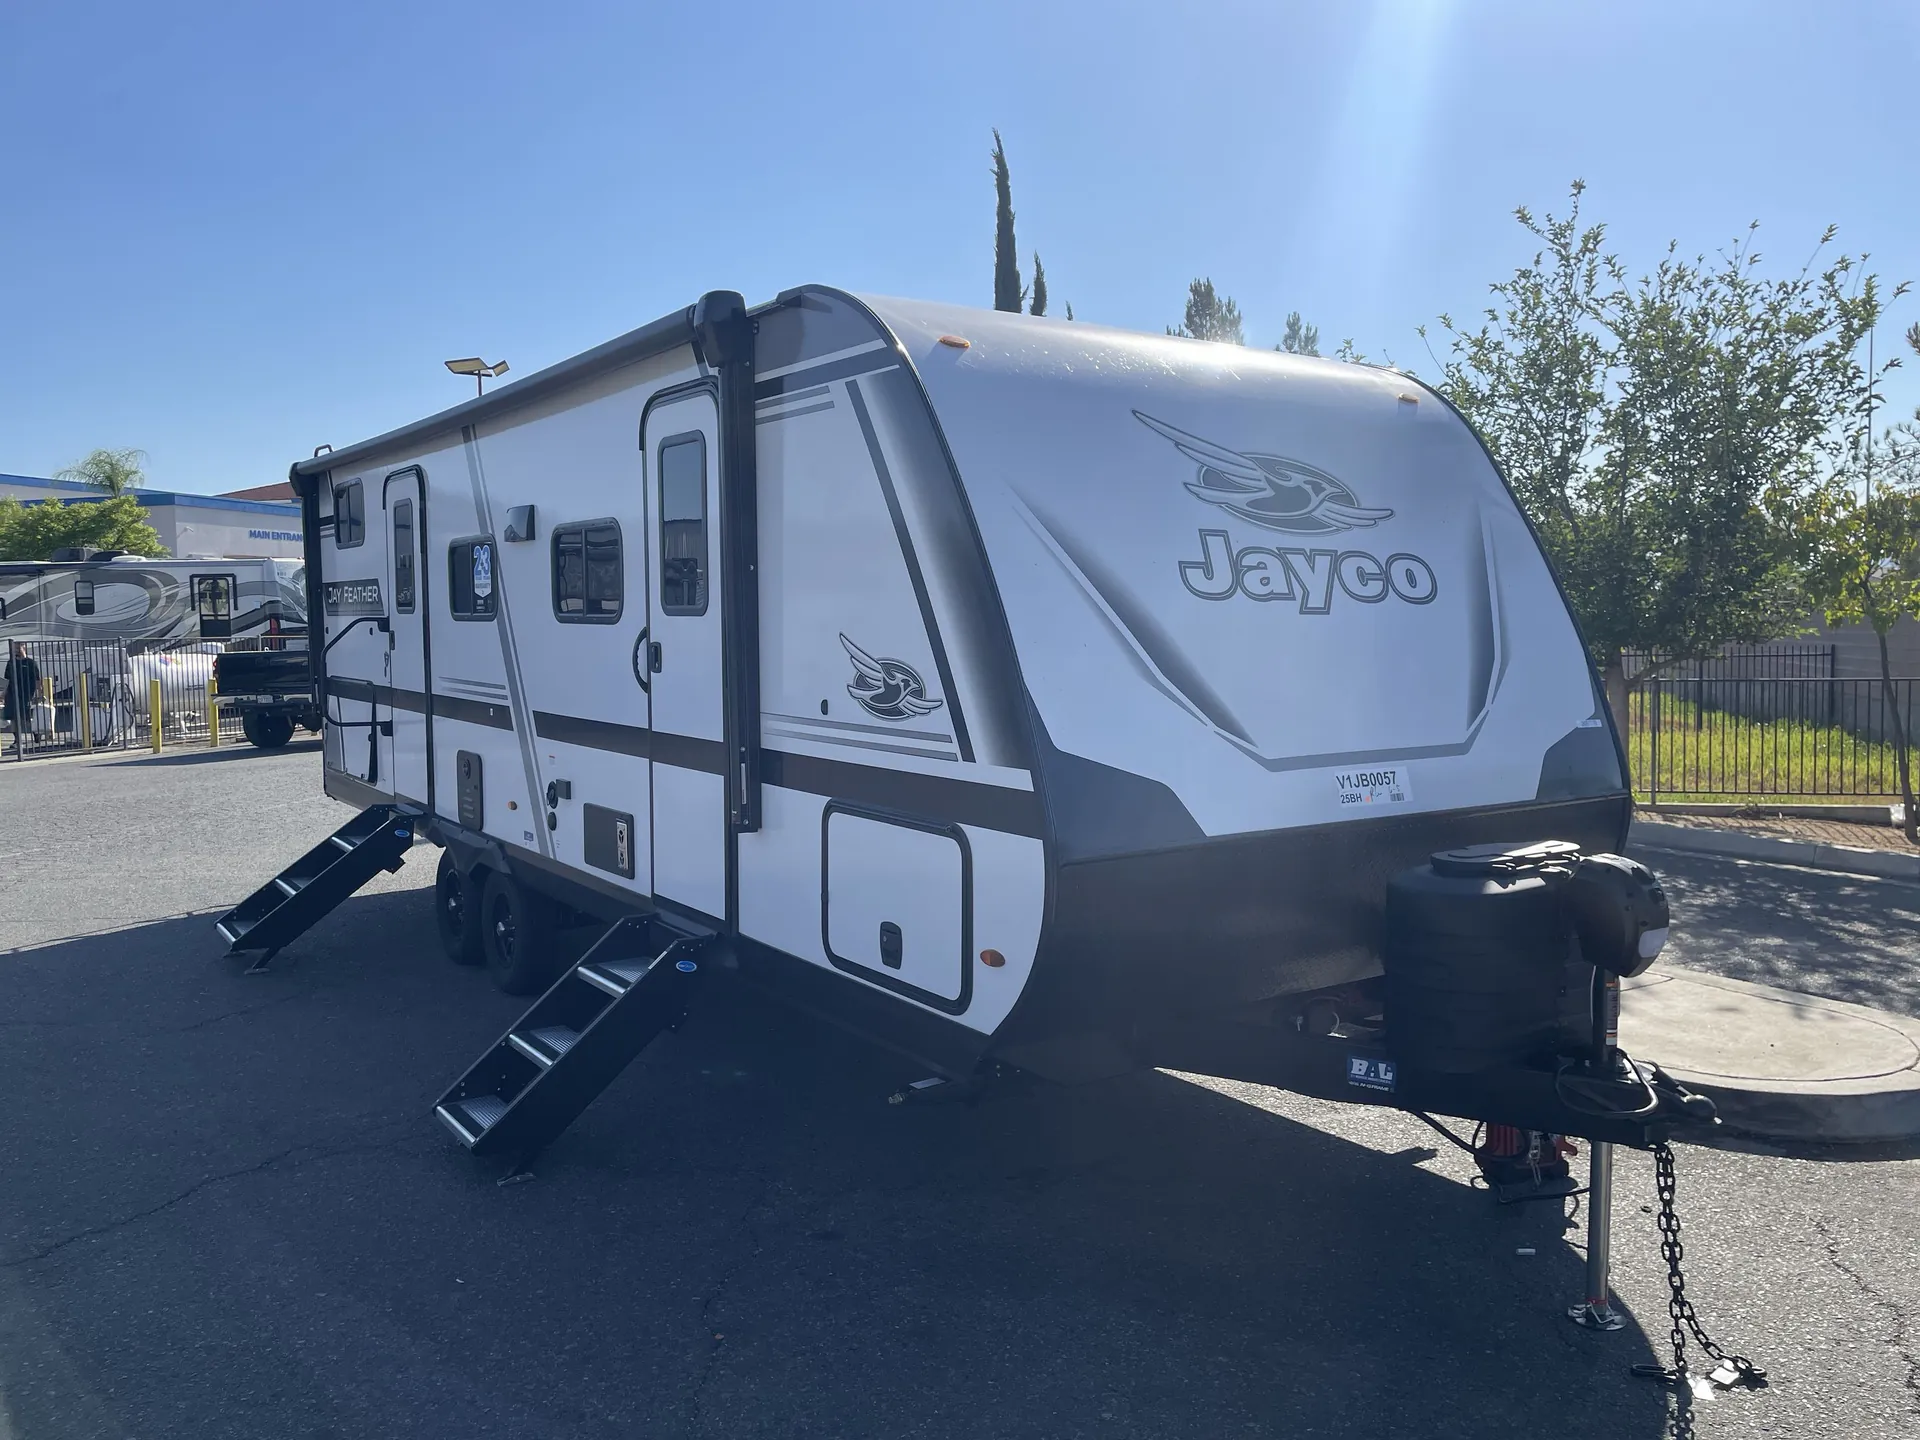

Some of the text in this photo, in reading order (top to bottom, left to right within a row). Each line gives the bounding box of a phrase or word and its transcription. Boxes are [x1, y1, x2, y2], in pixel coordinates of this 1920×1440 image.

[249, 529, 270, 540] MAIN
[1177, 528, 1438, 615] Jayco
[328, 585, 379, 603] JAY FEATHER
[1336, 771, 1396, 789] V1JB0057
[1340, 793, 1363, 804] 25BH
